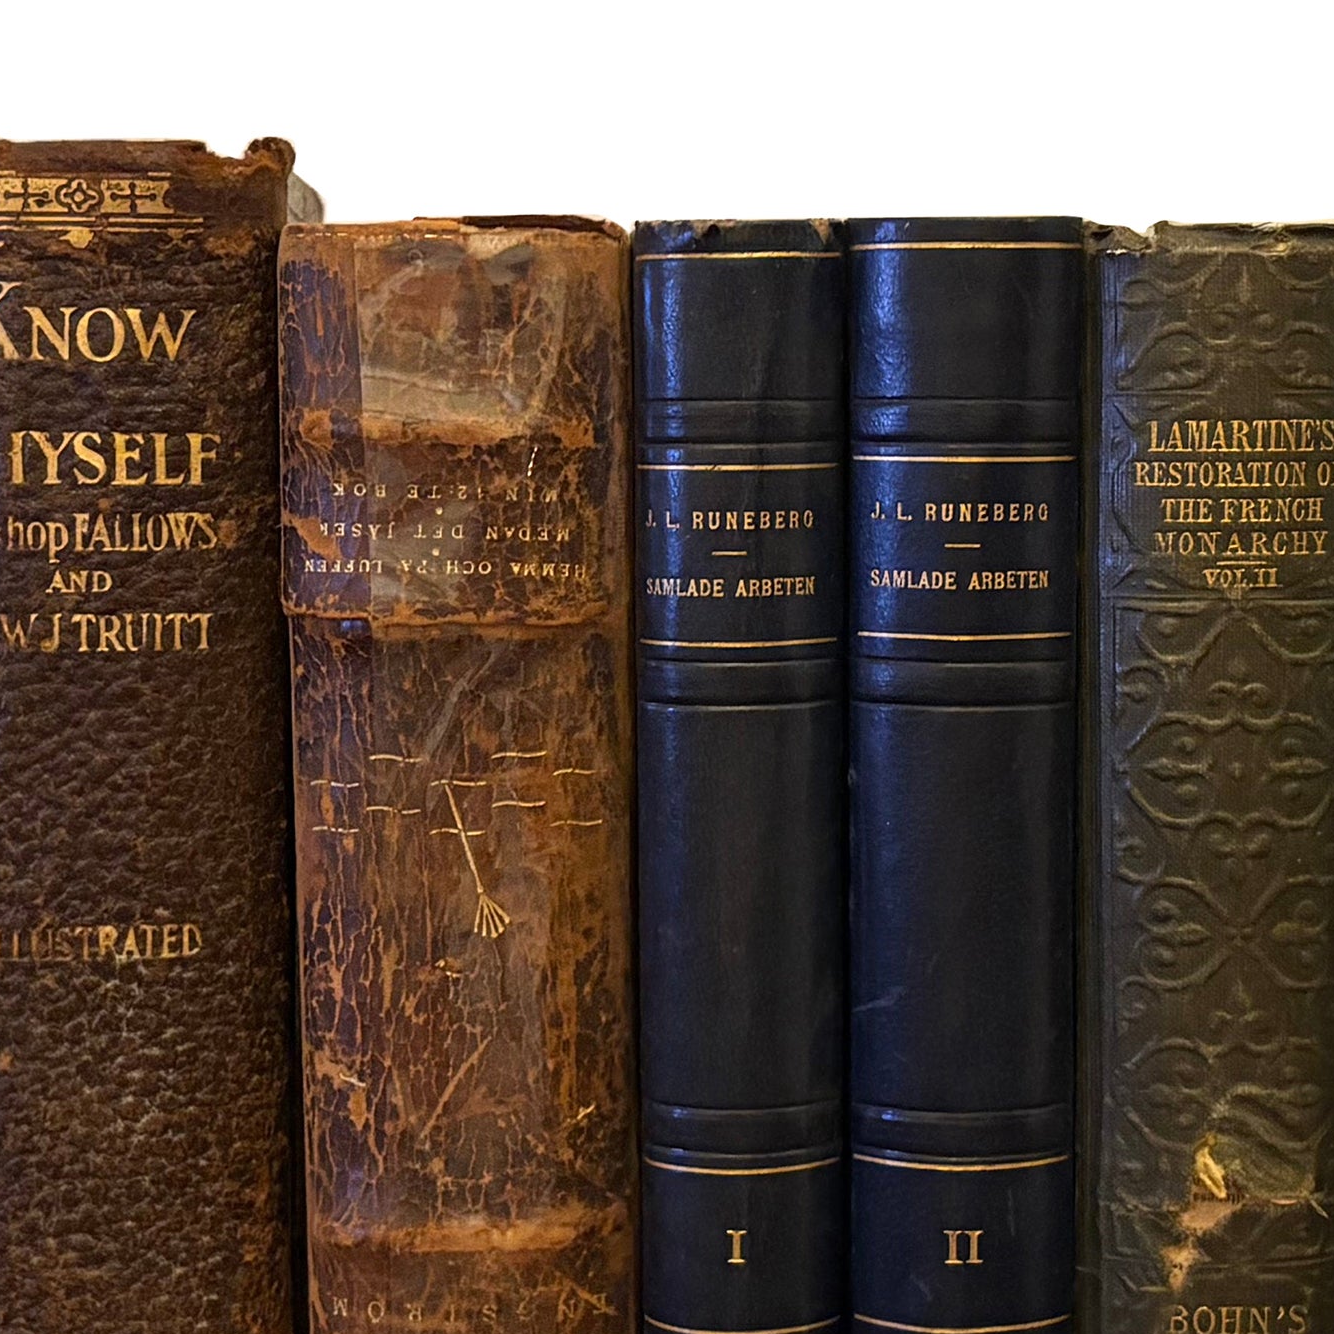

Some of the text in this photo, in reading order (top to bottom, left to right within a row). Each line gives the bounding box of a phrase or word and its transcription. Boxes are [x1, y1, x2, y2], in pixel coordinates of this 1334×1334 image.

[1133, 460, 1308, 487] RESTORATION
[332, 482, 387, 499] BOK
[504, 487, 558, 503] MIN
[665, 511, 681, 531] L.
[691, 509, 815, 531] RUNEBERG
[870, 501, 1050, 524] J. L. RUNEBERG
[1161, 497, 1325, 523] THE FRENCH
[72, 511, 218, 552] FALLOWS
[484, 525, 571, 543] MEDAN
[1151, 530, 1329, 556] MONARCHY
[303, 558, 383, 575] LUFFEN
[446, 559, 493, 575] OCH
[509, 562, 588, 580] HEMMA
[44, 569, 113, 594] AND
[645, 575, 816, 598] SAMLADE ARBETEN
[870, 569, 1050, 591] SAMLADE ARBETEN
[70, 612, 214, 653] TRUITT
[942, 1229, 985, 1265] II
